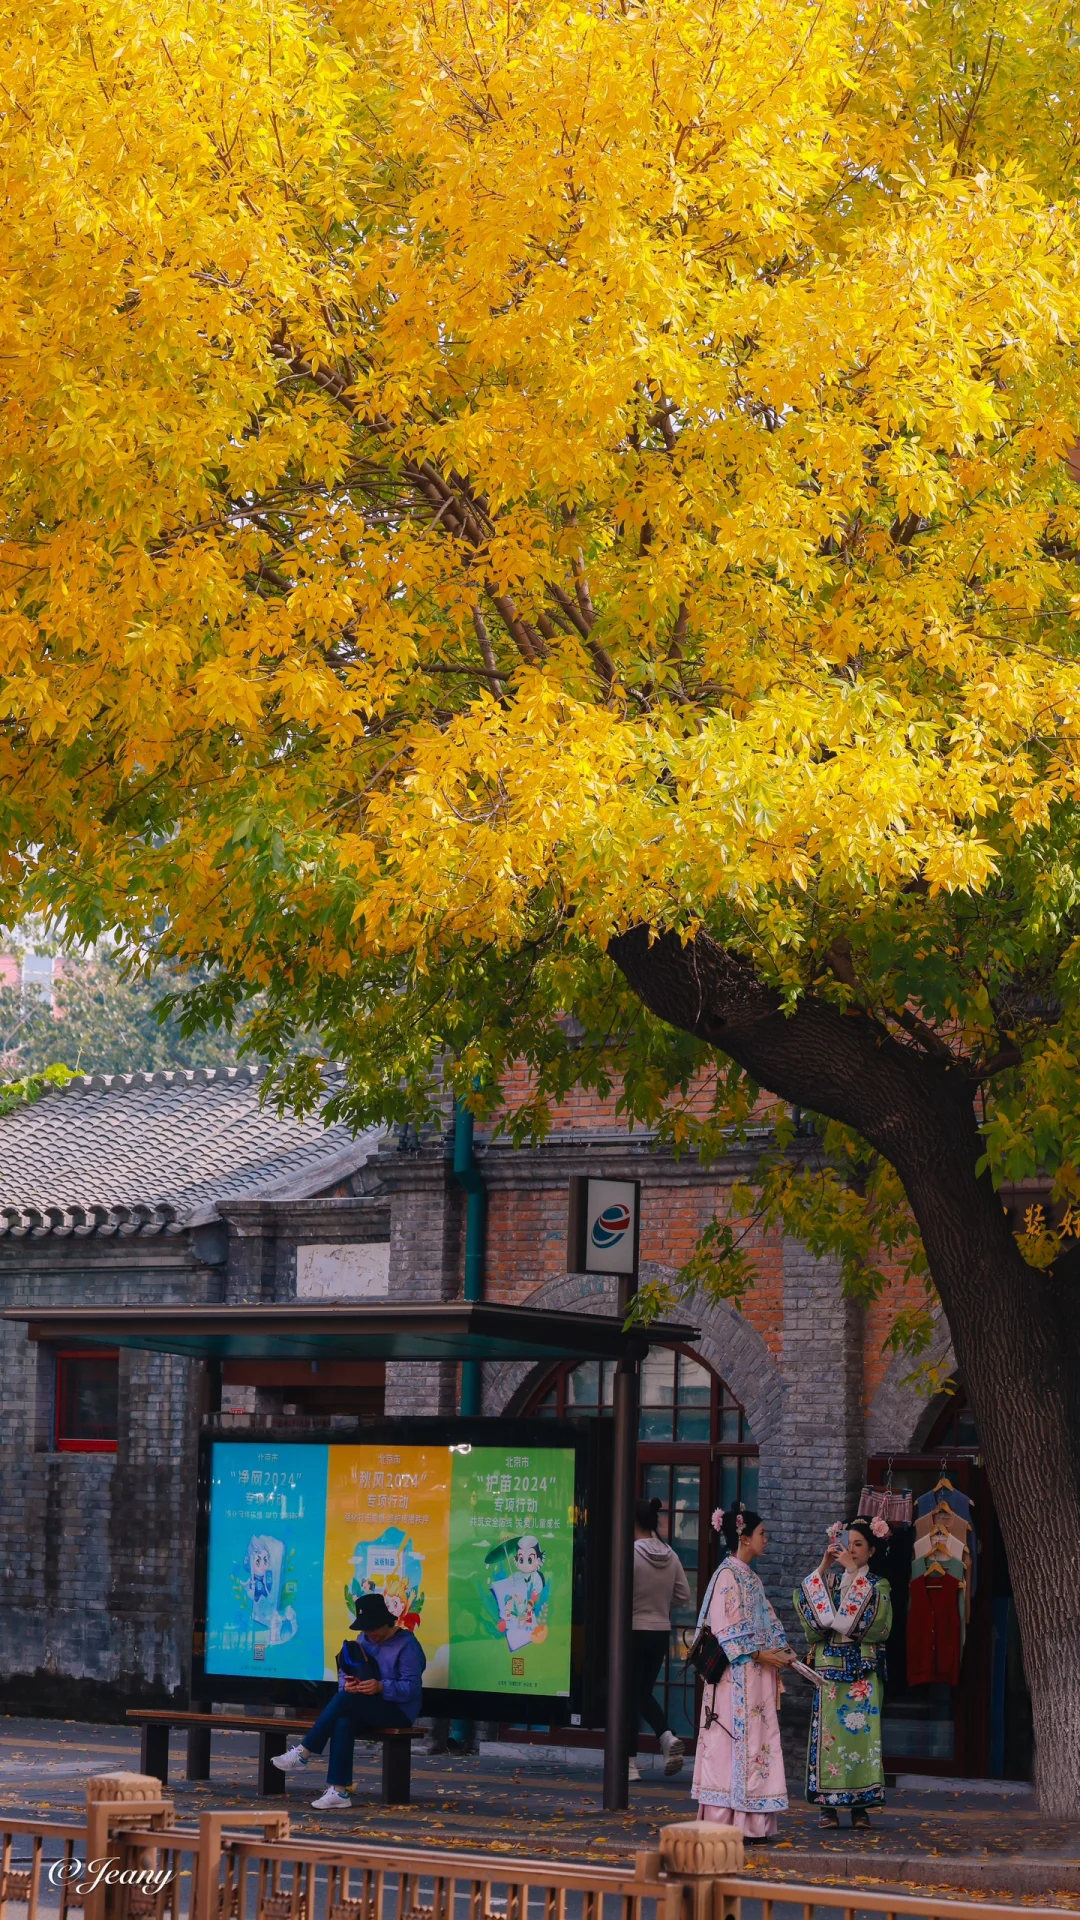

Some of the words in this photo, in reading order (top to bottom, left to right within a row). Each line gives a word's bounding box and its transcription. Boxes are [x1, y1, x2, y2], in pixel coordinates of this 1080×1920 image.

[379, 1454, 401, 1465] 北京市
[505, 1456, 529, 1468] 北京市
[367, 1493, 409, 1509] 专项行动
[494, 1498, 538, 1513] 专项行动
[469, 1516, 513, 1528] 共筑安全防线
[515, 1518, 561, 1529] 关爱儿童成长
